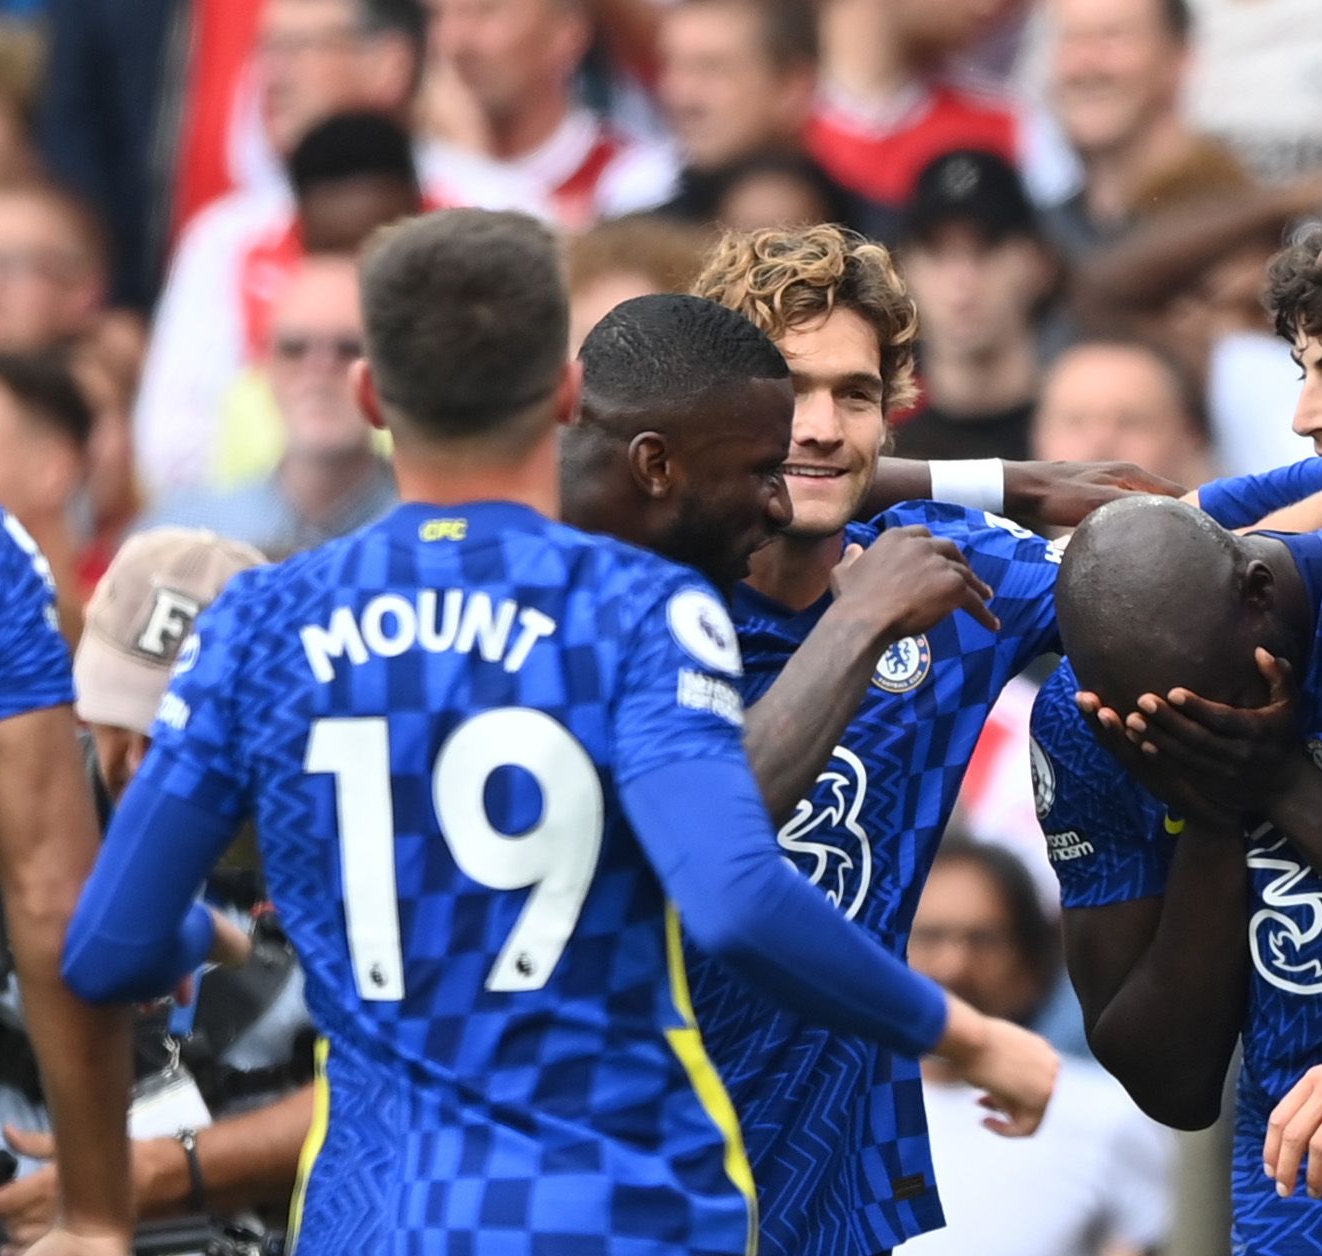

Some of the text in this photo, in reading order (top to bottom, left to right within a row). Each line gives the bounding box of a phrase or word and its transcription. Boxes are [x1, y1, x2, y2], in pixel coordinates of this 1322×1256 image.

[418, 518, 468, 542] CFC
[299, 589, 556, 683] MOUNT
[303, 707, 604, 1001] 19
